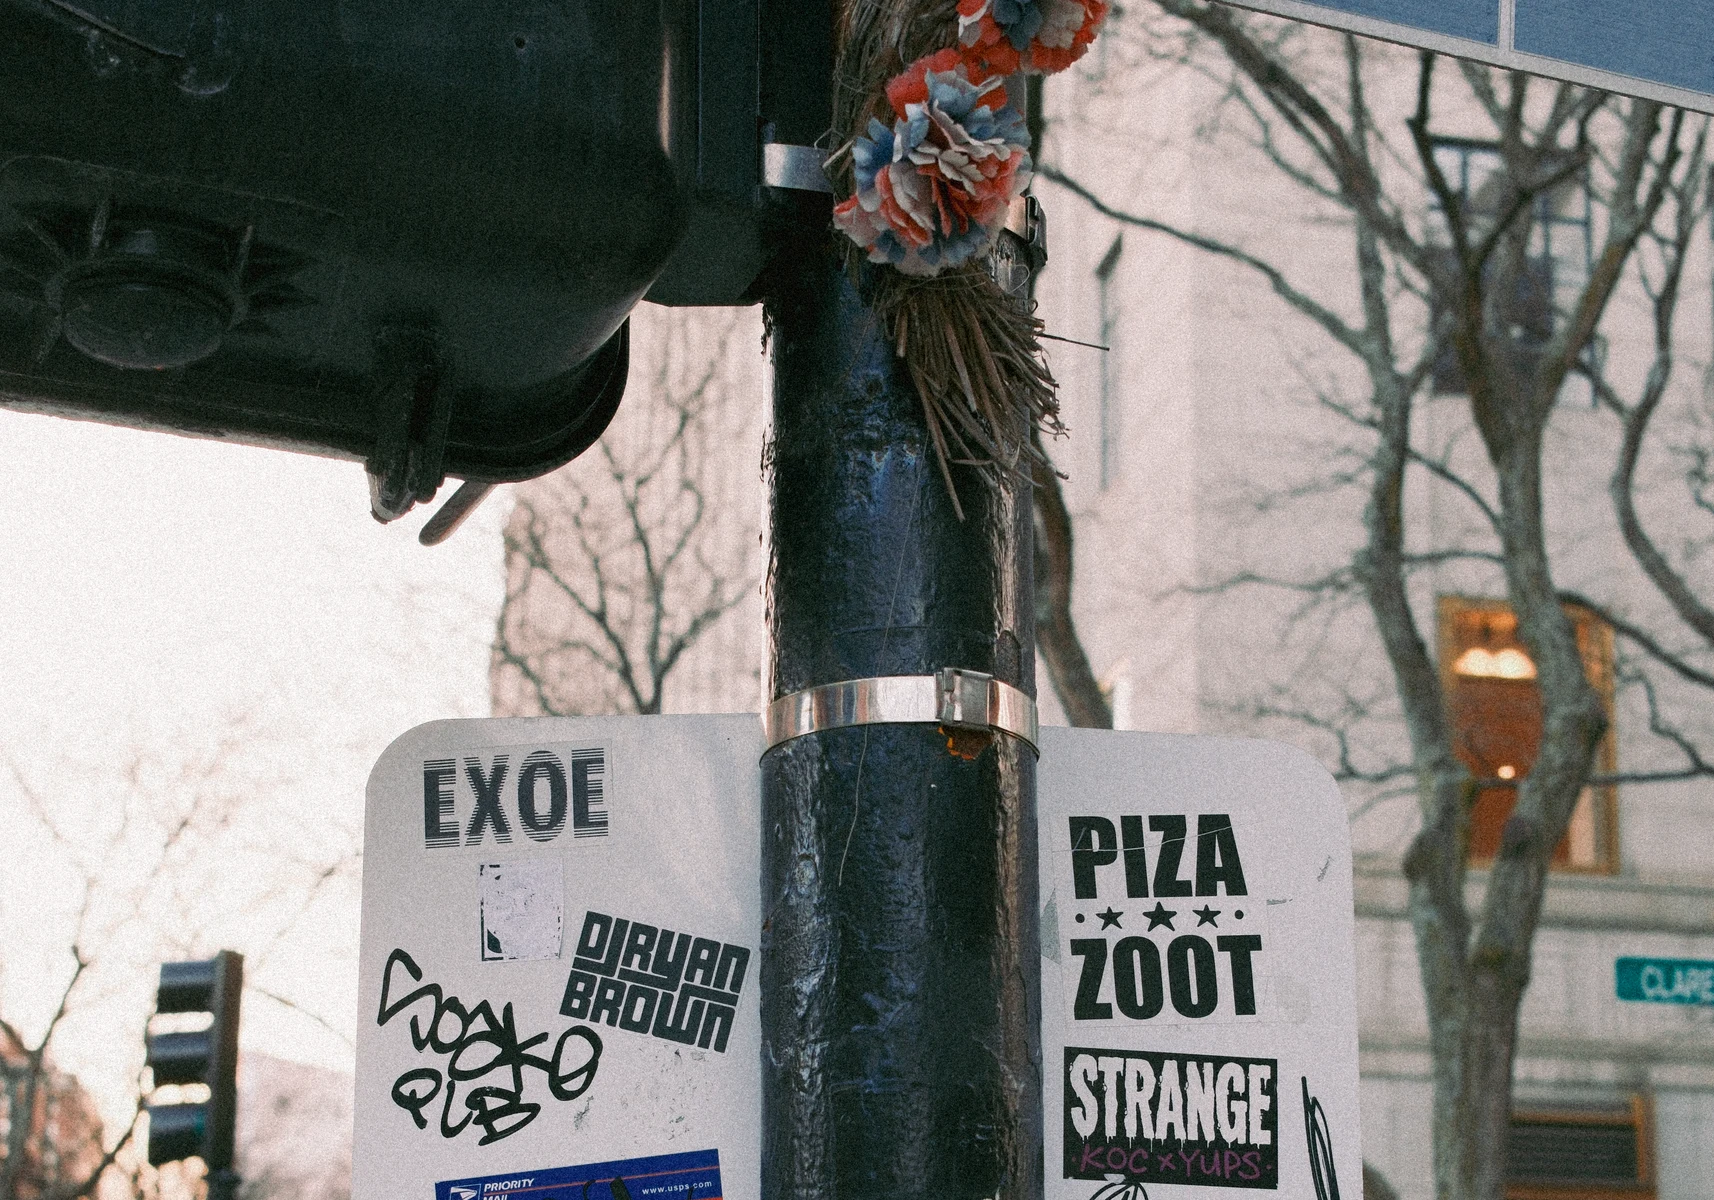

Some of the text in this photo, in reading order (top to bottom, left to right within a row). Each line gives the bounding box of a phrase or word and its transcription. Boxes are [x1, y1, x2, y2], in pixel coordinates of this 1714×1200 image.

[423, 748, 609, 849] EXOE
[1068, 813, 1248, 900] PIZA
[559, 970, 739, 1054] BROWN
[1069, 934, 1263, 1021] ZOOT
[1069, 1053, 1272, 1148] STRANGE
[484, 1178, 535, 1193] PRIORITY
